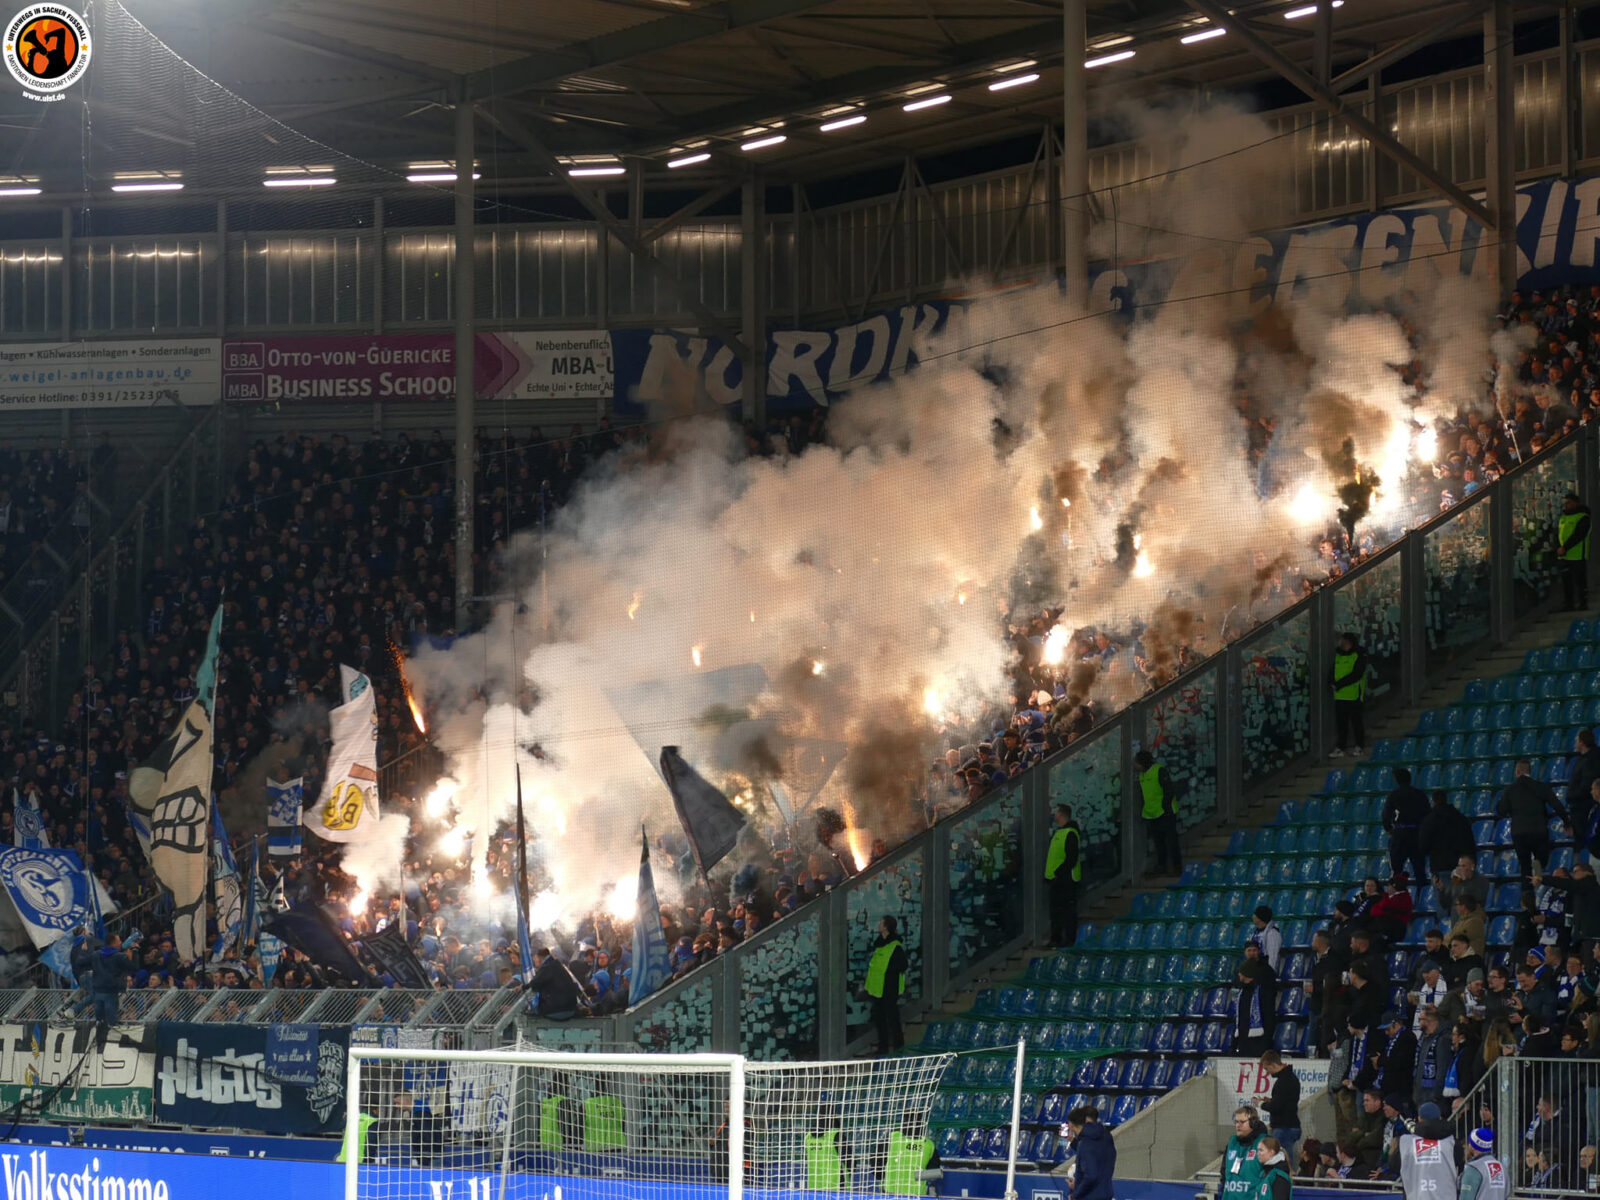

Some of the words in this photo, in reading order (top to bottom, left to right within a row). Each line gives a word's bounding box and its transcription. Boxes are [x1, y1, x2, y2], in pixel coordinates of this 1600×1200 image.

[37, 347, 128, 359] Kühlwasseranlagen
[139, 345, 211, 357] Sonderanlagen
[536, 340, 610, 351] Nebenberuflich
[230, 353, 259, 367] BBA
[228, 382, 259, 397] MBA
[267, 374, 372, 398] BUSINESS
[527, 383, 550, 393] Echte
[552, 383, 566, 392] Uni
[575, 382, 601, 391] Echter
[0, 393, 36, 403] Service
[39, 391, 79, 403] Hotline:
[1420, 1179, 1437, 1192] 25
